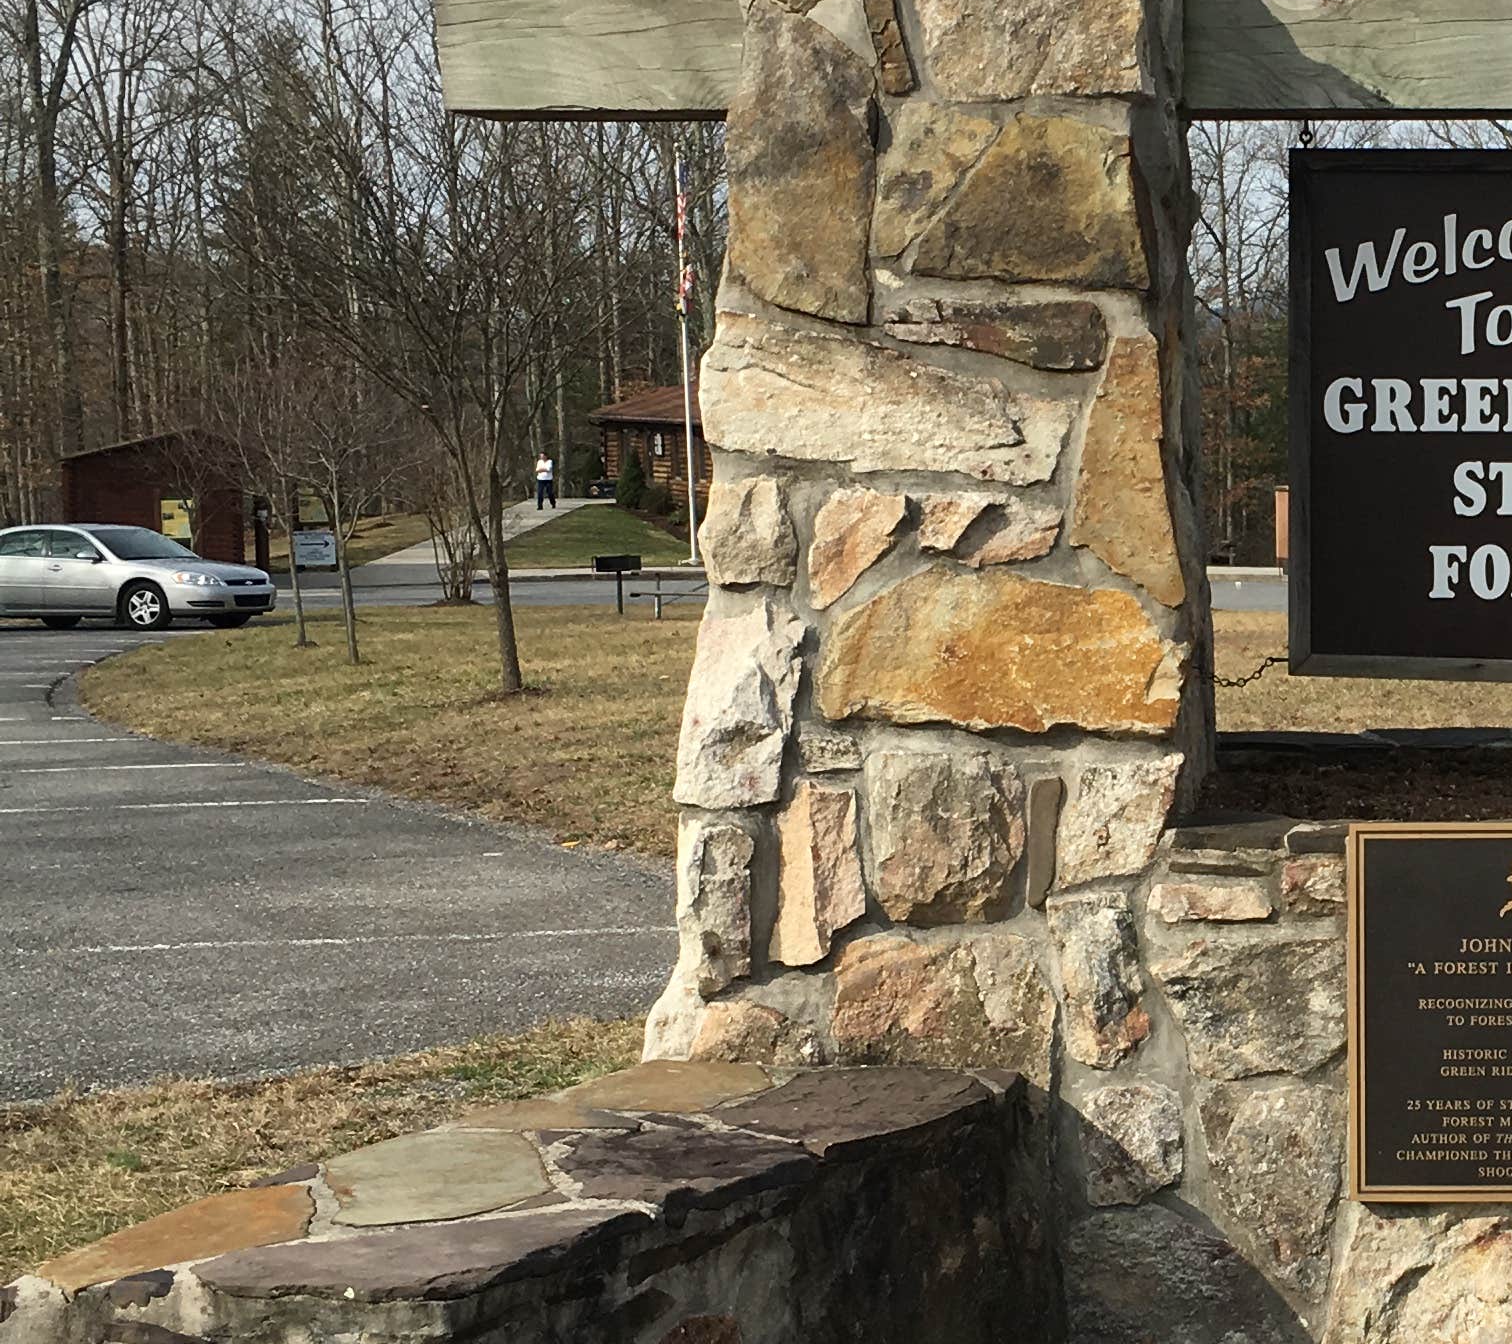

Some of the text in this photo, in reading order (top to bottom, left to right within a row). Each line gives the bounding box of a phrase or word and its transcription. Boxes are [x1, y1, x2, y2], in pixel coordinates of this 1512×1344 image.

[1460, 939, 1511, 952] JOHN
[1434, 962, 1498, 974] FOREST
[1419, 999, 1512, 1009] RECOGNIZING
[1447, 1015, 1464, 1026] TO
[1444, 1049, 1506, 1059] HISTORIC
[1441, 1066, 1485, 1077] GREEN
[1408, 1100, 1420, 1110] 25
[1427, 1100, 1470, 1110] YEARS
[1477, 1099, 1494, 1110] OF
[1443, 1116, 1494, 1127] FOREST
[1412, 1133, 1467, 1144] AUTHOR
[1473, 1133, 1490, 1144] OF
[1397, 1150, 1487, 1161] CHAMPIONED
